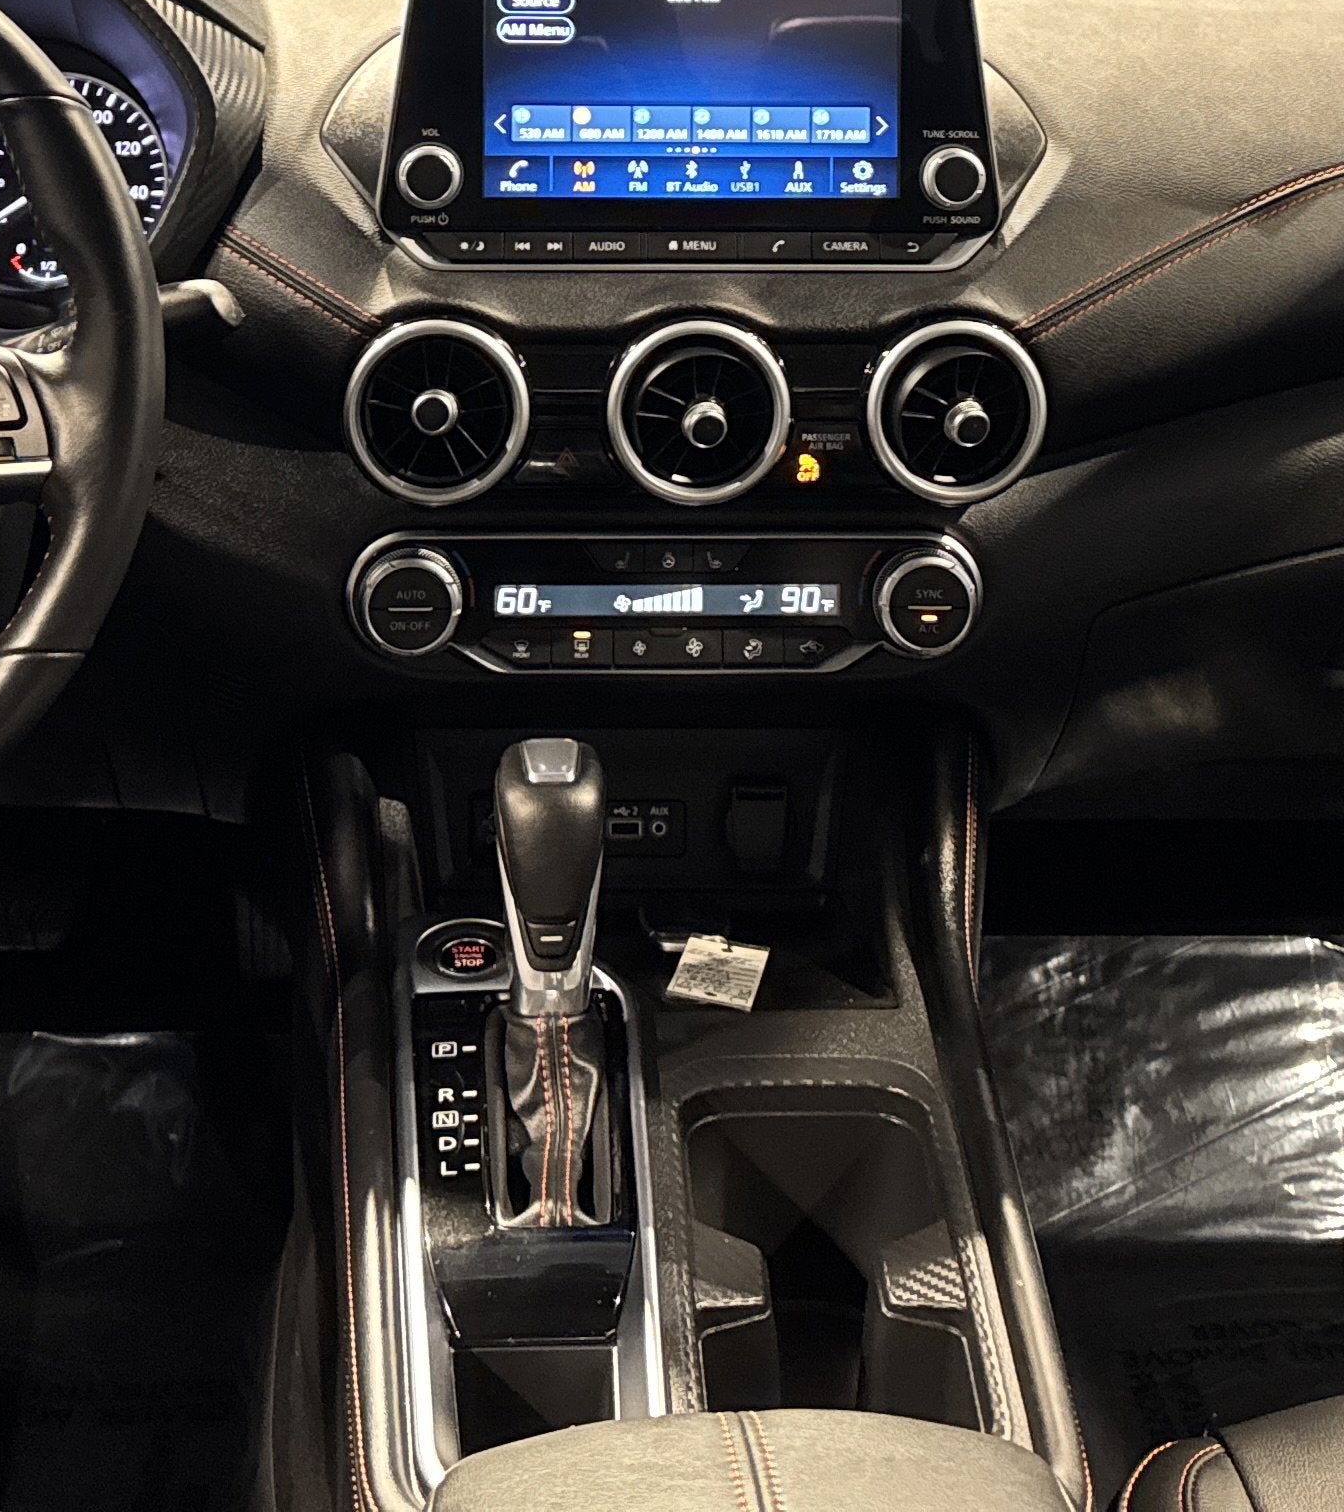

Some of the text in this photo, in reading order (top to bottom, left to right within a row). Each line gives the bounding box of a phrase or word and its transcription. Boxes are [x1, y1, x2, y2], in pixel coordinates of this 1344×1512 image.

[500, 23, 570, 37] AM Menu
[91, 109, 114, 126] 00
[420, 127, 441, 137] VOL
[114, 140, 142, 157] 120
[129, 184, 150, 200] 40
[499, 180, 538, 193] Phone
[572, 180, 596, 193] AM
[628, 181, 649, 193] FM
[682, 181, 719, 193] Audio
[730, 181, 760, 193] USB1
[784, 181, 814, 193] AUX
[839, 181, 888, 196] Settings
[410, 215, 436, 224] PUSH
[922, 215, 981, 225] PUSH SOUND
[587, 240, 627, 252] AUDIO
[682, 240, 718, 252] MENU
[822, 241, 869, 252] CAMERA
[39, 260, 58, 272] 1/2
[801, 432, 852, 442] PASSENGER
[808, 442, 845, 451] AIR BAG
[395, 589, 427, 601] AUTO
[914, 589, 944, 600] SYNC
[918, 624, 940, 635] A/C
[649, 805, 670, 817] AUX
[451, 945, 486, 954] START
[454, 958, 485, 968] STOP
[438, 1043, 452, 1056] P
[438, 1087, 455, 1104] R
[438, 1112, 454, 1126] N
[438, 1136, 458, 1153] D
[440, 1160, 458, 1177] L
